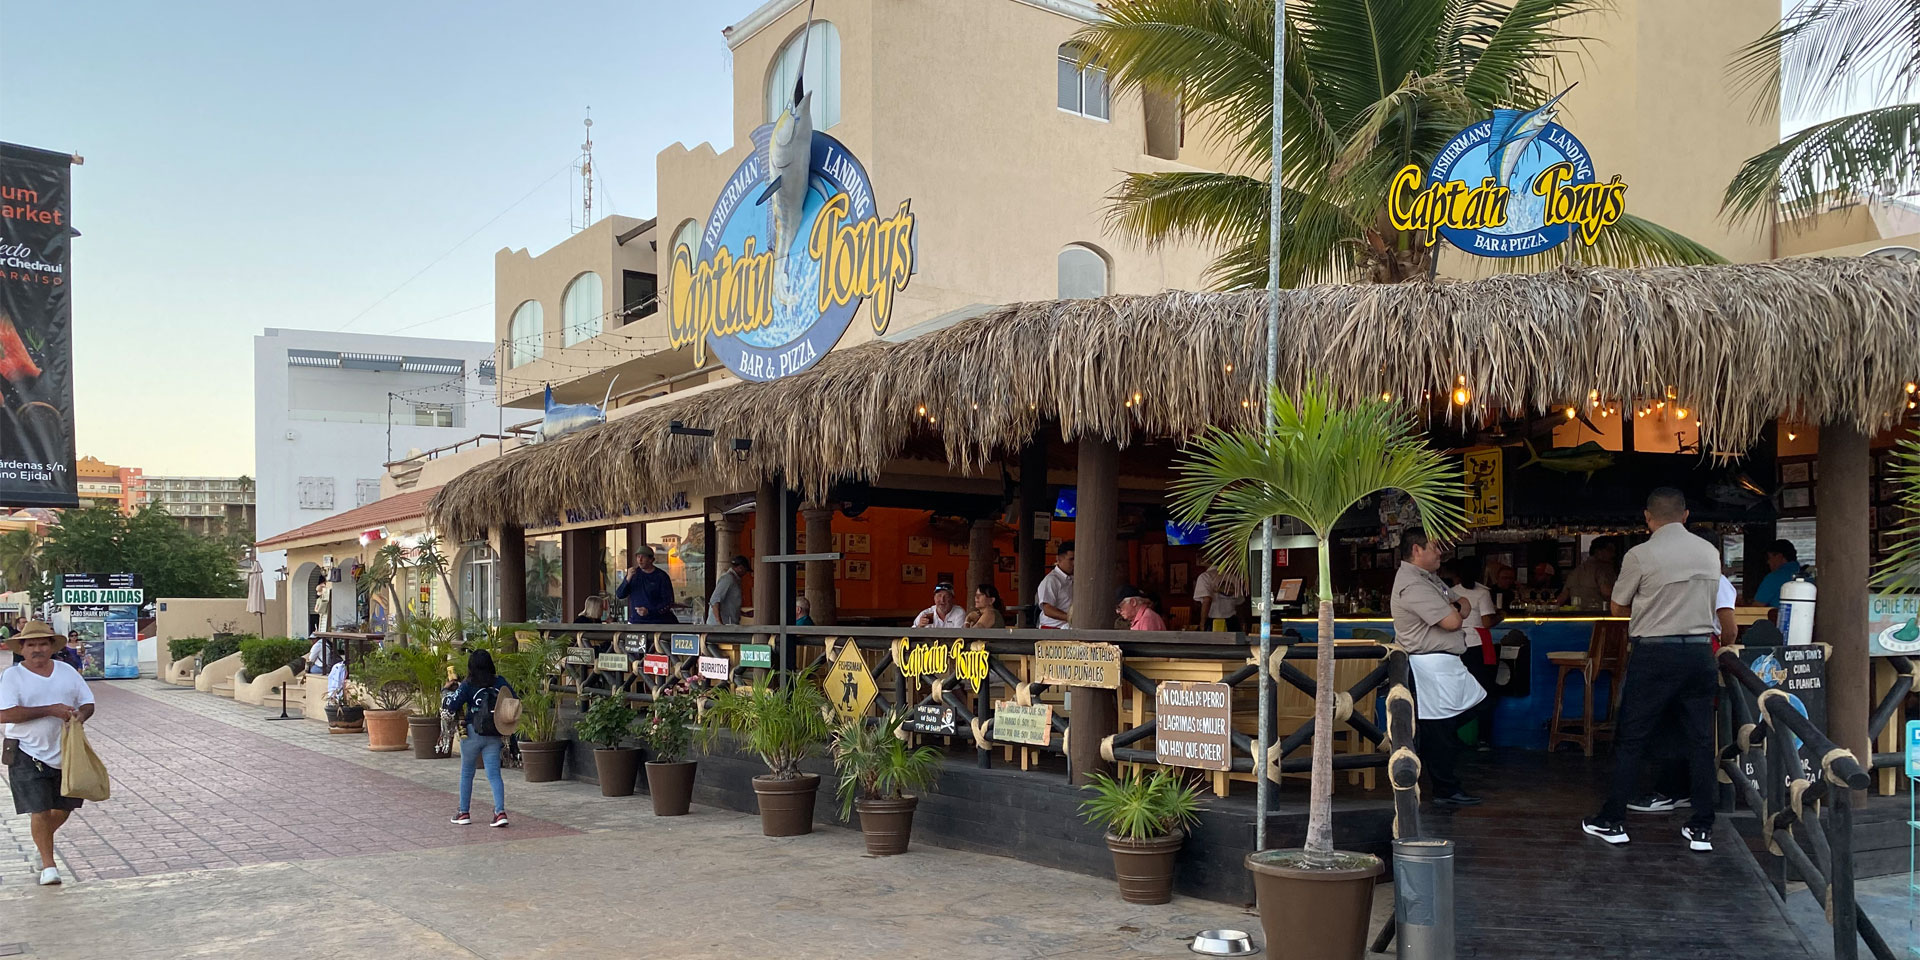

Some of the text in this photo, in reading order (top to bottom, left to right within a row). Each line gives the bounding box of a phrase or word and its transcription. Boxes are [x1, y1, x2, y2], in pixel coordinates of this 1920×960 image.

[1431, 123, 1491, 180] FISHERMAN'S
[1549, 128, 1591, 180] LANDING
[822, 146, 870, 219] LANDING
[1388, 161, 1628, 247] Captain Tony's
[1474, 233, 1548, 252] BAR & PIZZA
[6, 257, 62, 273] Chedraui
[667, 193, 914, 369] Captain Tony's
[739, 338, 817, 379] BAR & PIZZA
[20, 471, 52, 481] Ejidal
[64, 590, 142, 603] CABO ZAIDAS
[674, 639, 694, 650] PIZZA
[1038, 645, 1044, 659] EL
[1063, 646, 1089, 660] DESCUBRE
[700, 662, 727, 675] BURRITOS
[838, 661, 862, 672] FISHERMAN
[899, 636, 948, 691] Captain
[1056, 664, 1071, 679] VINO
[1074, 662, 1104, 682] PUÑALES
[1793, 664, 1810, 674] CUIDA
[1789, 678, 1821, 689] EL PLANETA
[1195, 691, 1202, 706] DE
[1203, 691, 1225, 708] PERRO
[1163, 714, 1196, 733] LAGRIMAS
[1196, 718, 1203, 732] DE
[1159, 739, 1169, 756] NO
[1170, 740, 1183, 757] HAY
[1185, 742, 1198, 759] QUE
